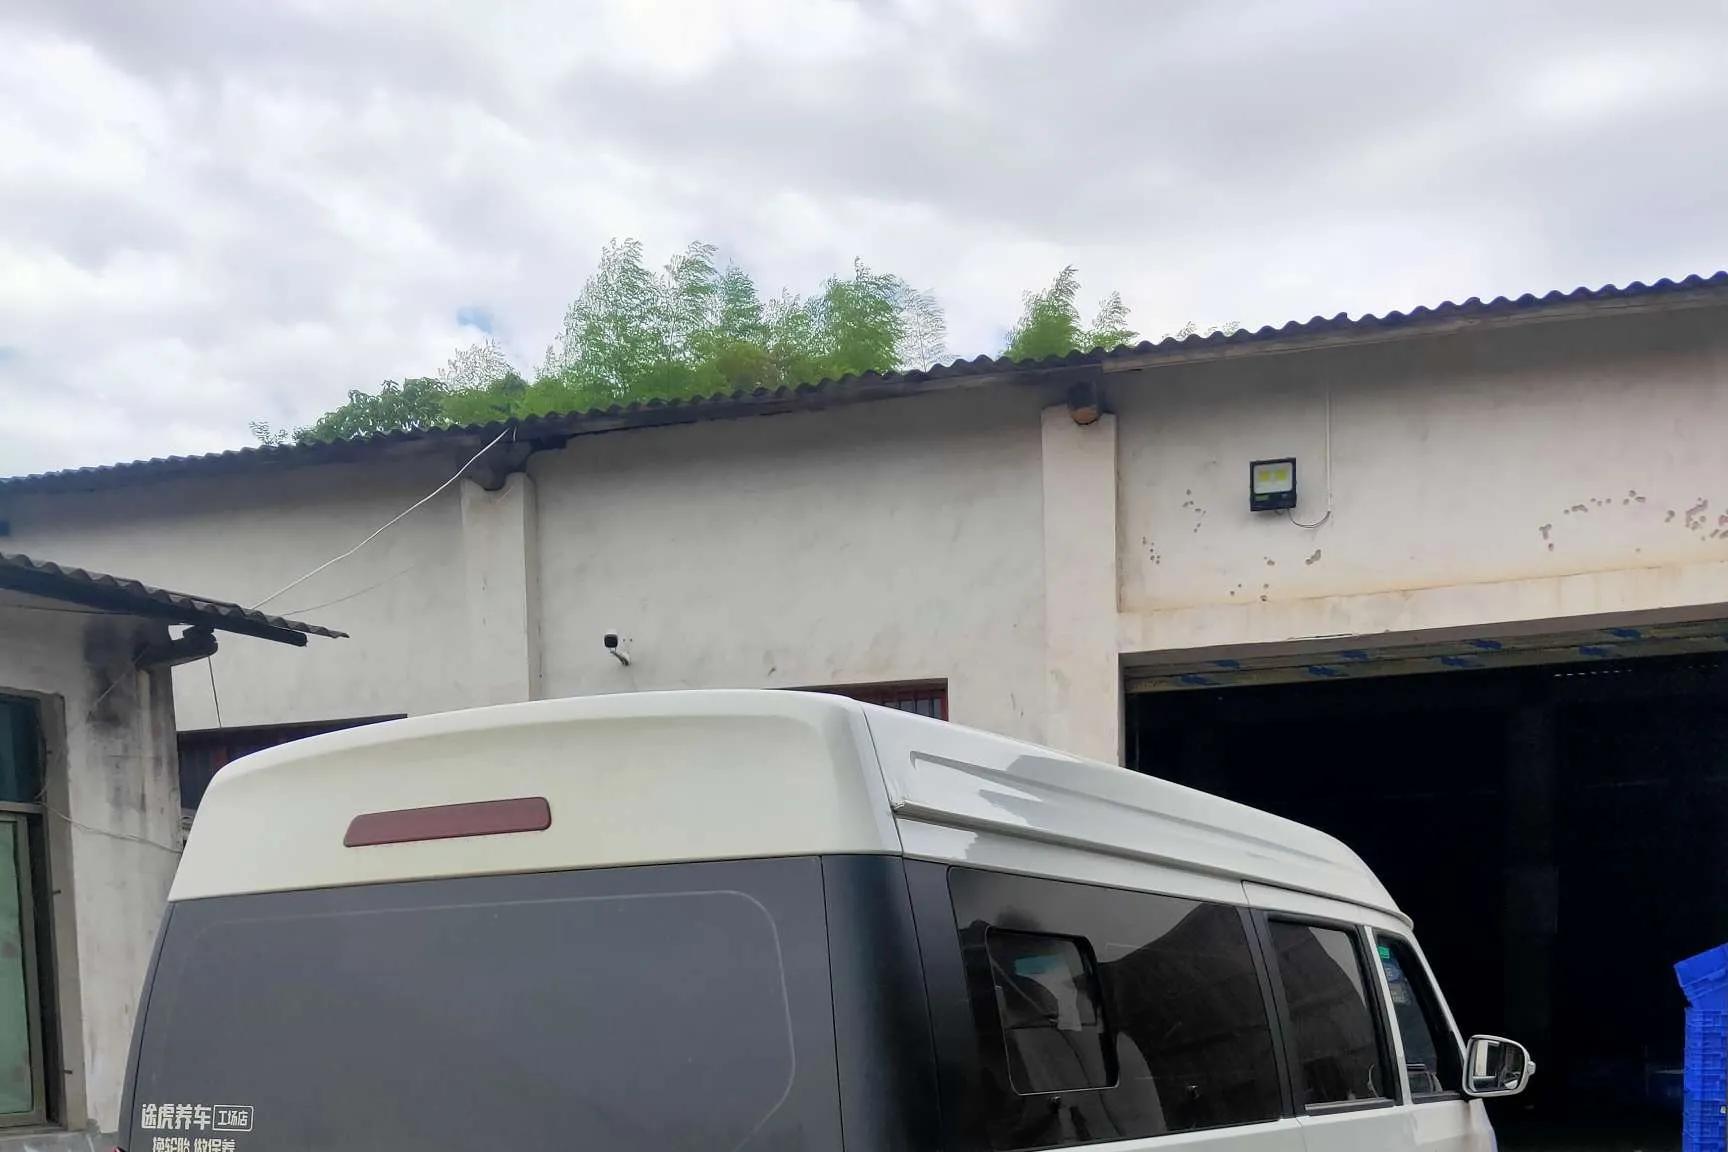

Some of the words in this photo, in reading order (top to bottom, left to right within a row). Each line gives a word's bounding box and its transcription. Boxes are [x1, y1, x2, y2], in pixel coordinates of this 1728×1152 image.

[141, 1103, 211, 1130] 途虎养车
[217, 1110, 249, 1126] 工场店
